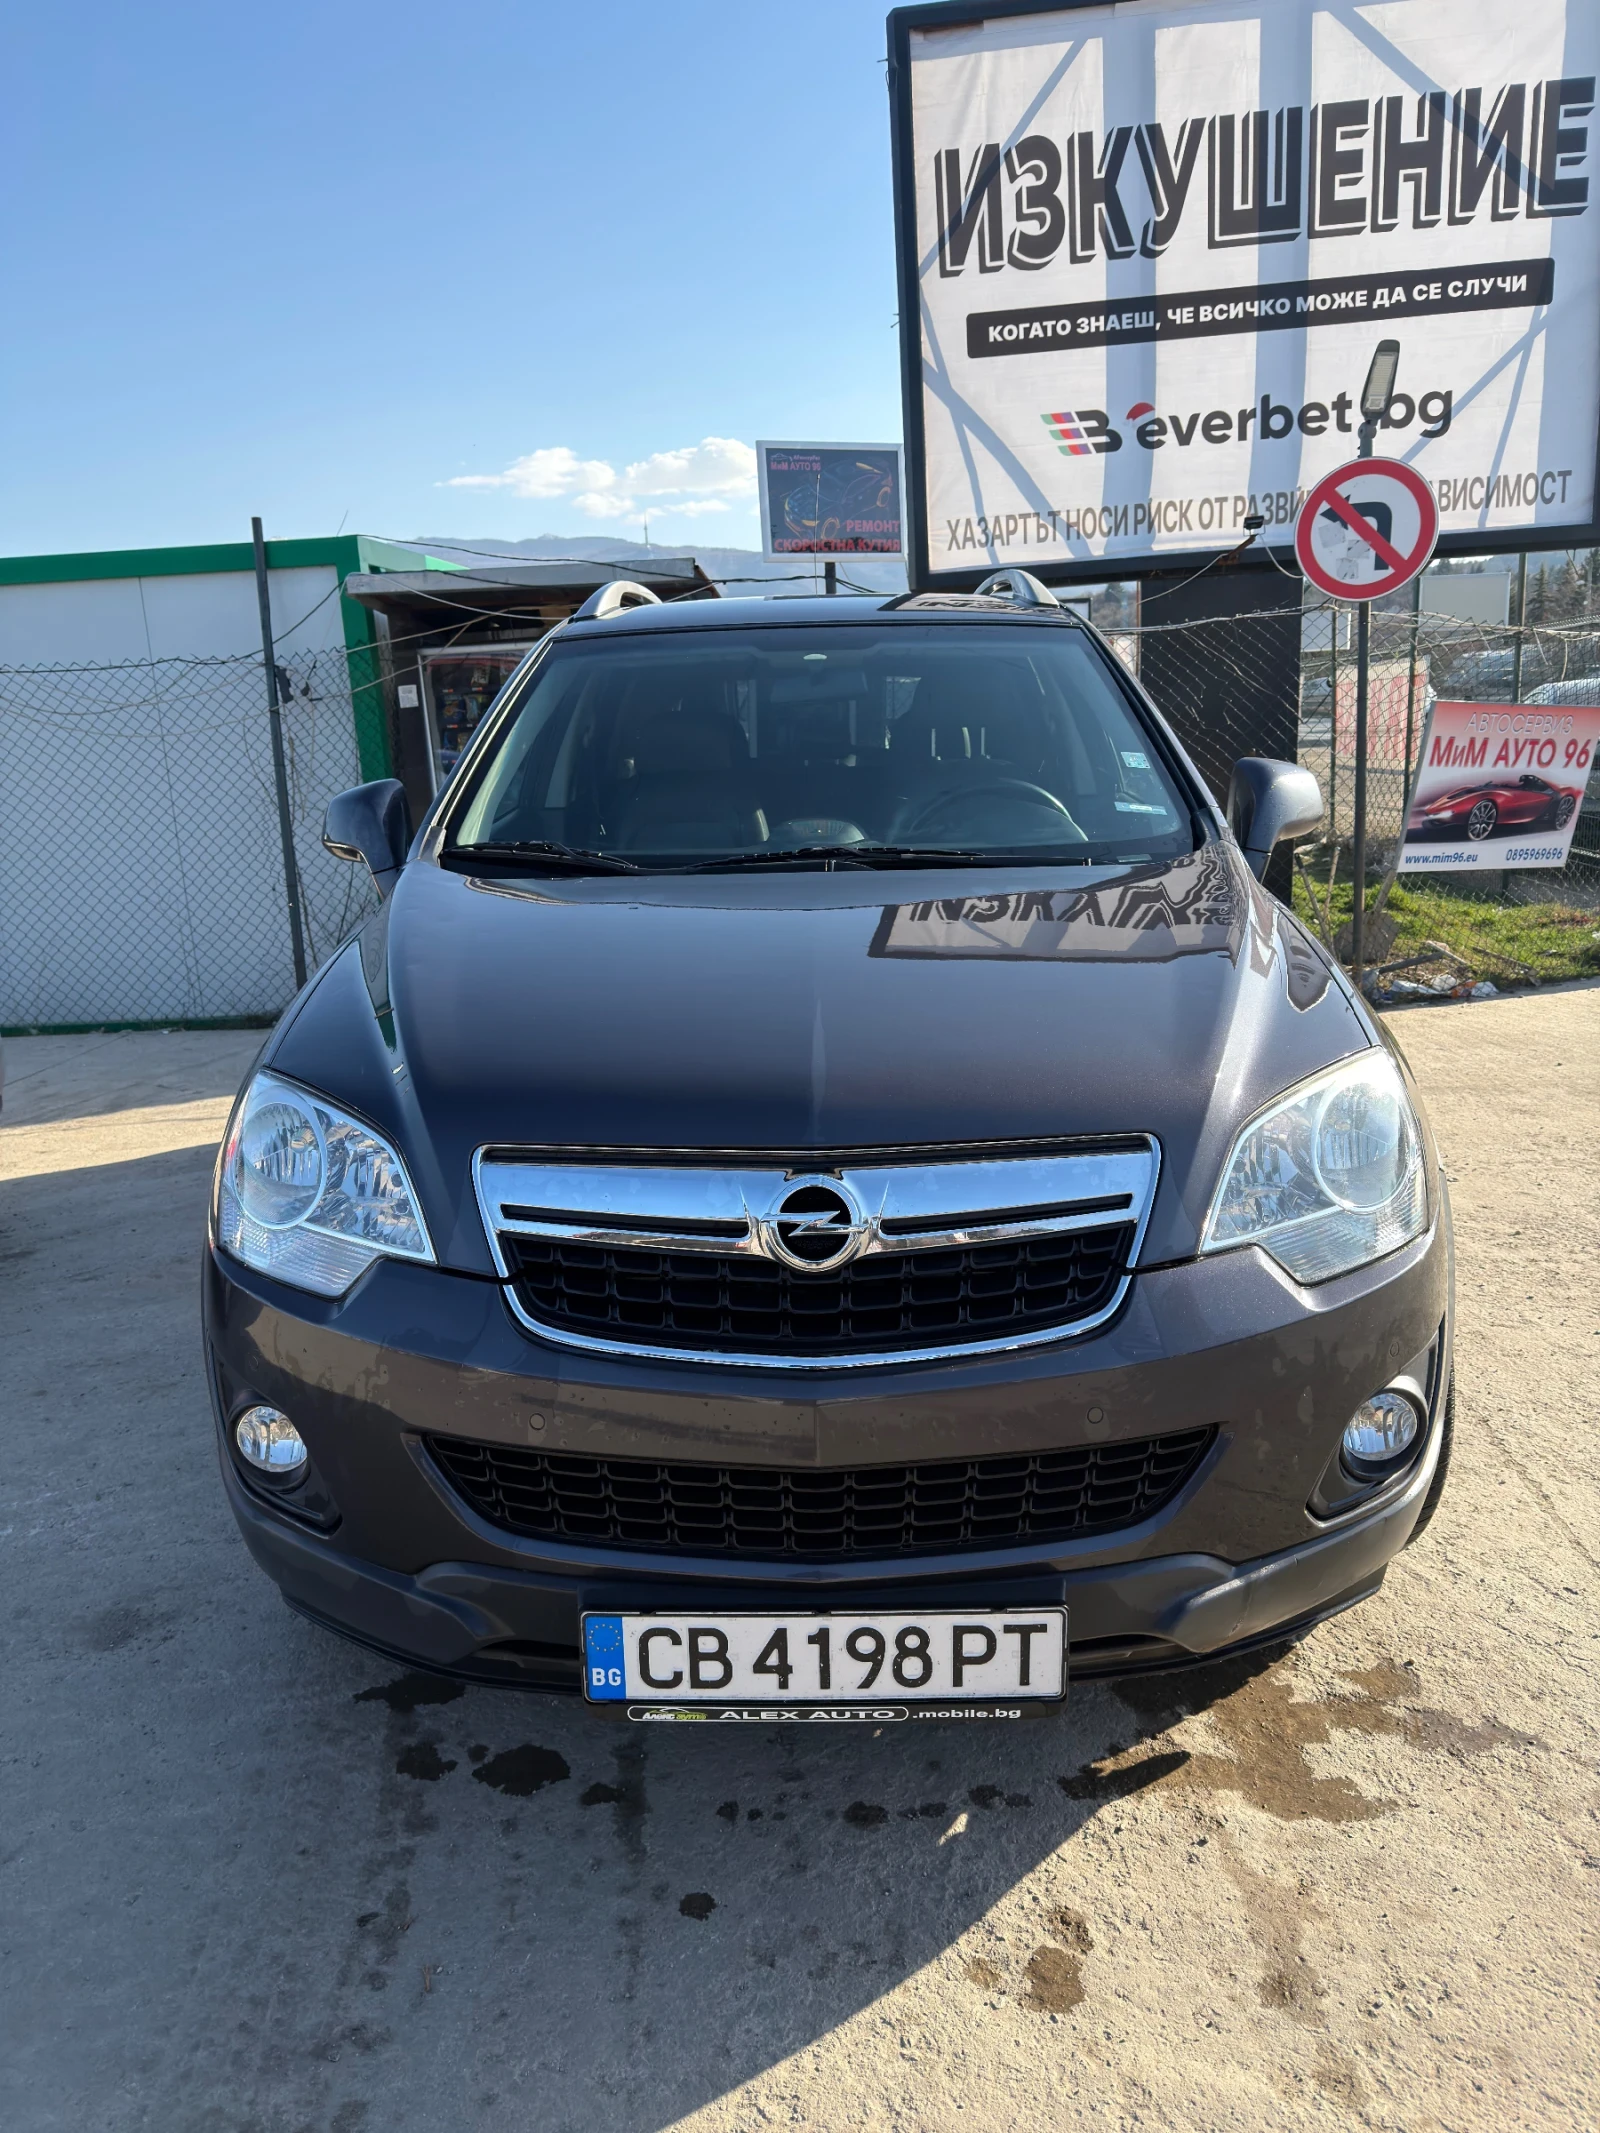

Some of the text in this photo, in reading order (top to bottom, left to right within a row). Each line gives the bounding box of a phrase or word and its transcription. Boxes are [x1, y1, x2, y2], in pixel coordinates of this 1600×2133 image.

[933, 77, 1596, 278] ИЗКУШЕНИЕ
[988, 275, 1528, 343] КОГАТО ЗНАЕШ, ЧЕ ВСИЧКО МОЖЕ ДА СЕ СЛУЧИ
[1136, 390, 1453, 450] everbetbg
[790, 461, 811, 471] АУТО
[947, 470, 1572, 551] ХАЗАРТЪТ НОСИ РИСК ОТ РАЗВИ ВИСИМОСТ
[846, 520, 900, 533] РЕМОНТ
[774, 539, 901, 552] СКОРОСТНА КУТИЯ
[1465, 712, 1574, 735] АВТОСЕРВИЗ
[1429, 736, 1592, 769] МиМ АУТО 96
[1405, 848, 1563, 864] www.mim96.eu 0895969696
[638, 1623, 1048, 1690] CB 4198 PT
[592, 1667, 622, 1686] BG
[719, 1711, 800, 1719] ALEX
[809, 1710, 895, 1719] AUTO
